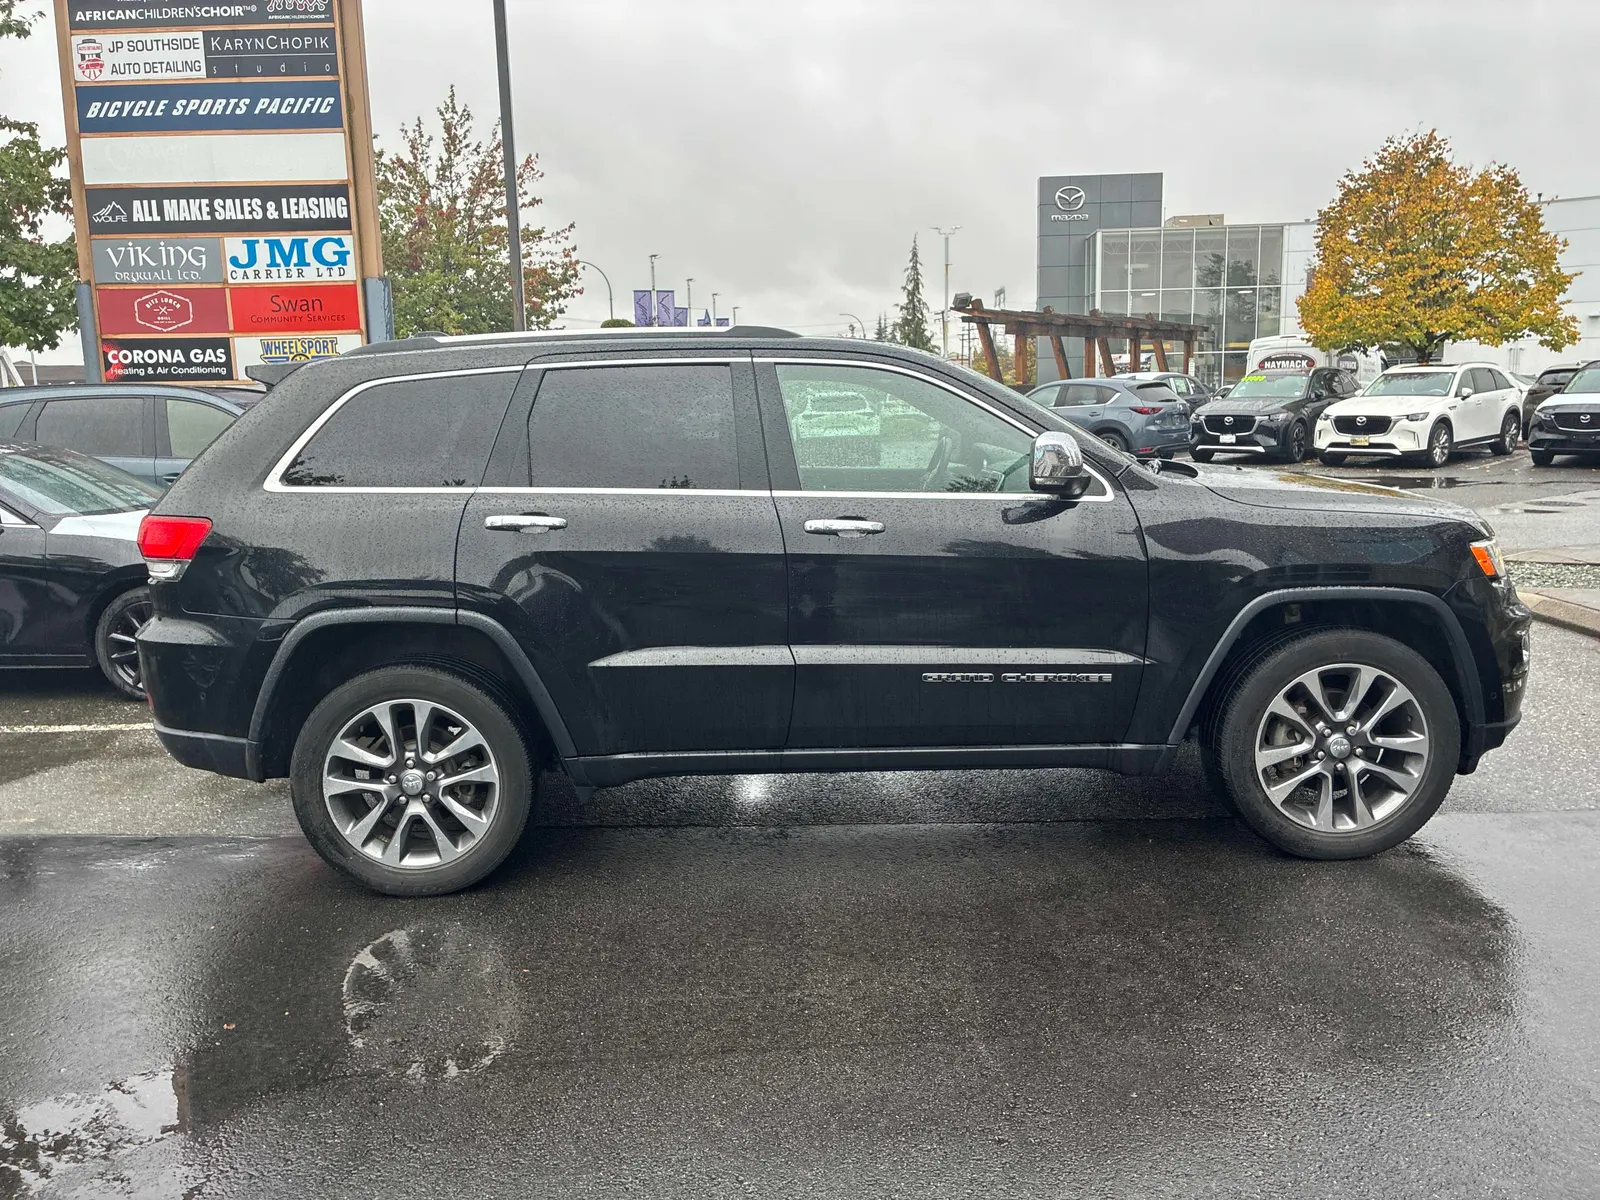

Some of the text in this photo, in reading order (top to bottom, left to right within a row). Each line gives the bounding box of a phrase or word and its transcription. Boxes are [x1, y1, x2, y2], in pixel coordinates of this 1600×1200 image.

[108, 38, 200, 53] JP SOUTHSIDE
[111, 60, 201, 75] AUTO DETAILING
[86, 97, 335, 118] BICYCLE SPORTS PACIFIC
[133, 196, 348, 222] ALL MAKE SALES & LEASING
[92, 215, 128, 223] WOLFE
[229, 237, 350, 269] JMG
[230, 267, 346, 280] CARRIER LTD
[270, 295, 323, 312] Swan
[250, 314, 346, 323] COMMUNITY SERVICES
[107, 348, 227, 364] CORONA GAS
[111, 367, 145, 376] Heating
[156, 366, 169, 374] Air
[171, 365, 227, 375] Conditioning
[1264, 360, 1308, 369] HAYMACK
[922, 673, 1112, 683] GRAND CHEROKEE
